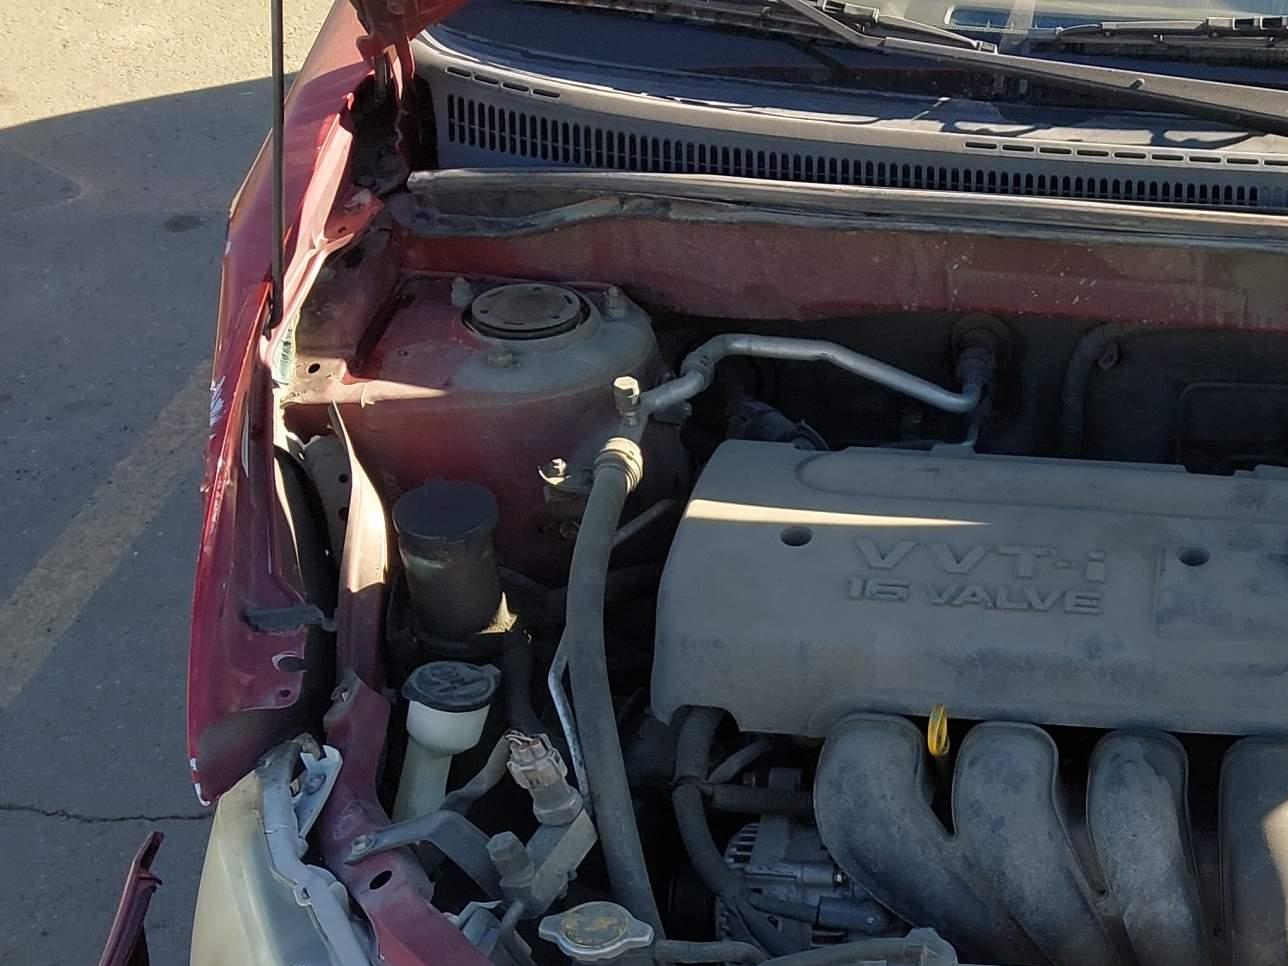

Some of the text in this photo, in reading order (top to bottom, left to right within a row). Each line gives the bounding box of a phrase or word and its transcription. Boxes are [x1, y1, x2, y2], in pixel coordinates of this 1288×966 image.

[854, 537, 1106, 583] VVT-i
[846, 575, 1104, 616] 16 VALVE
